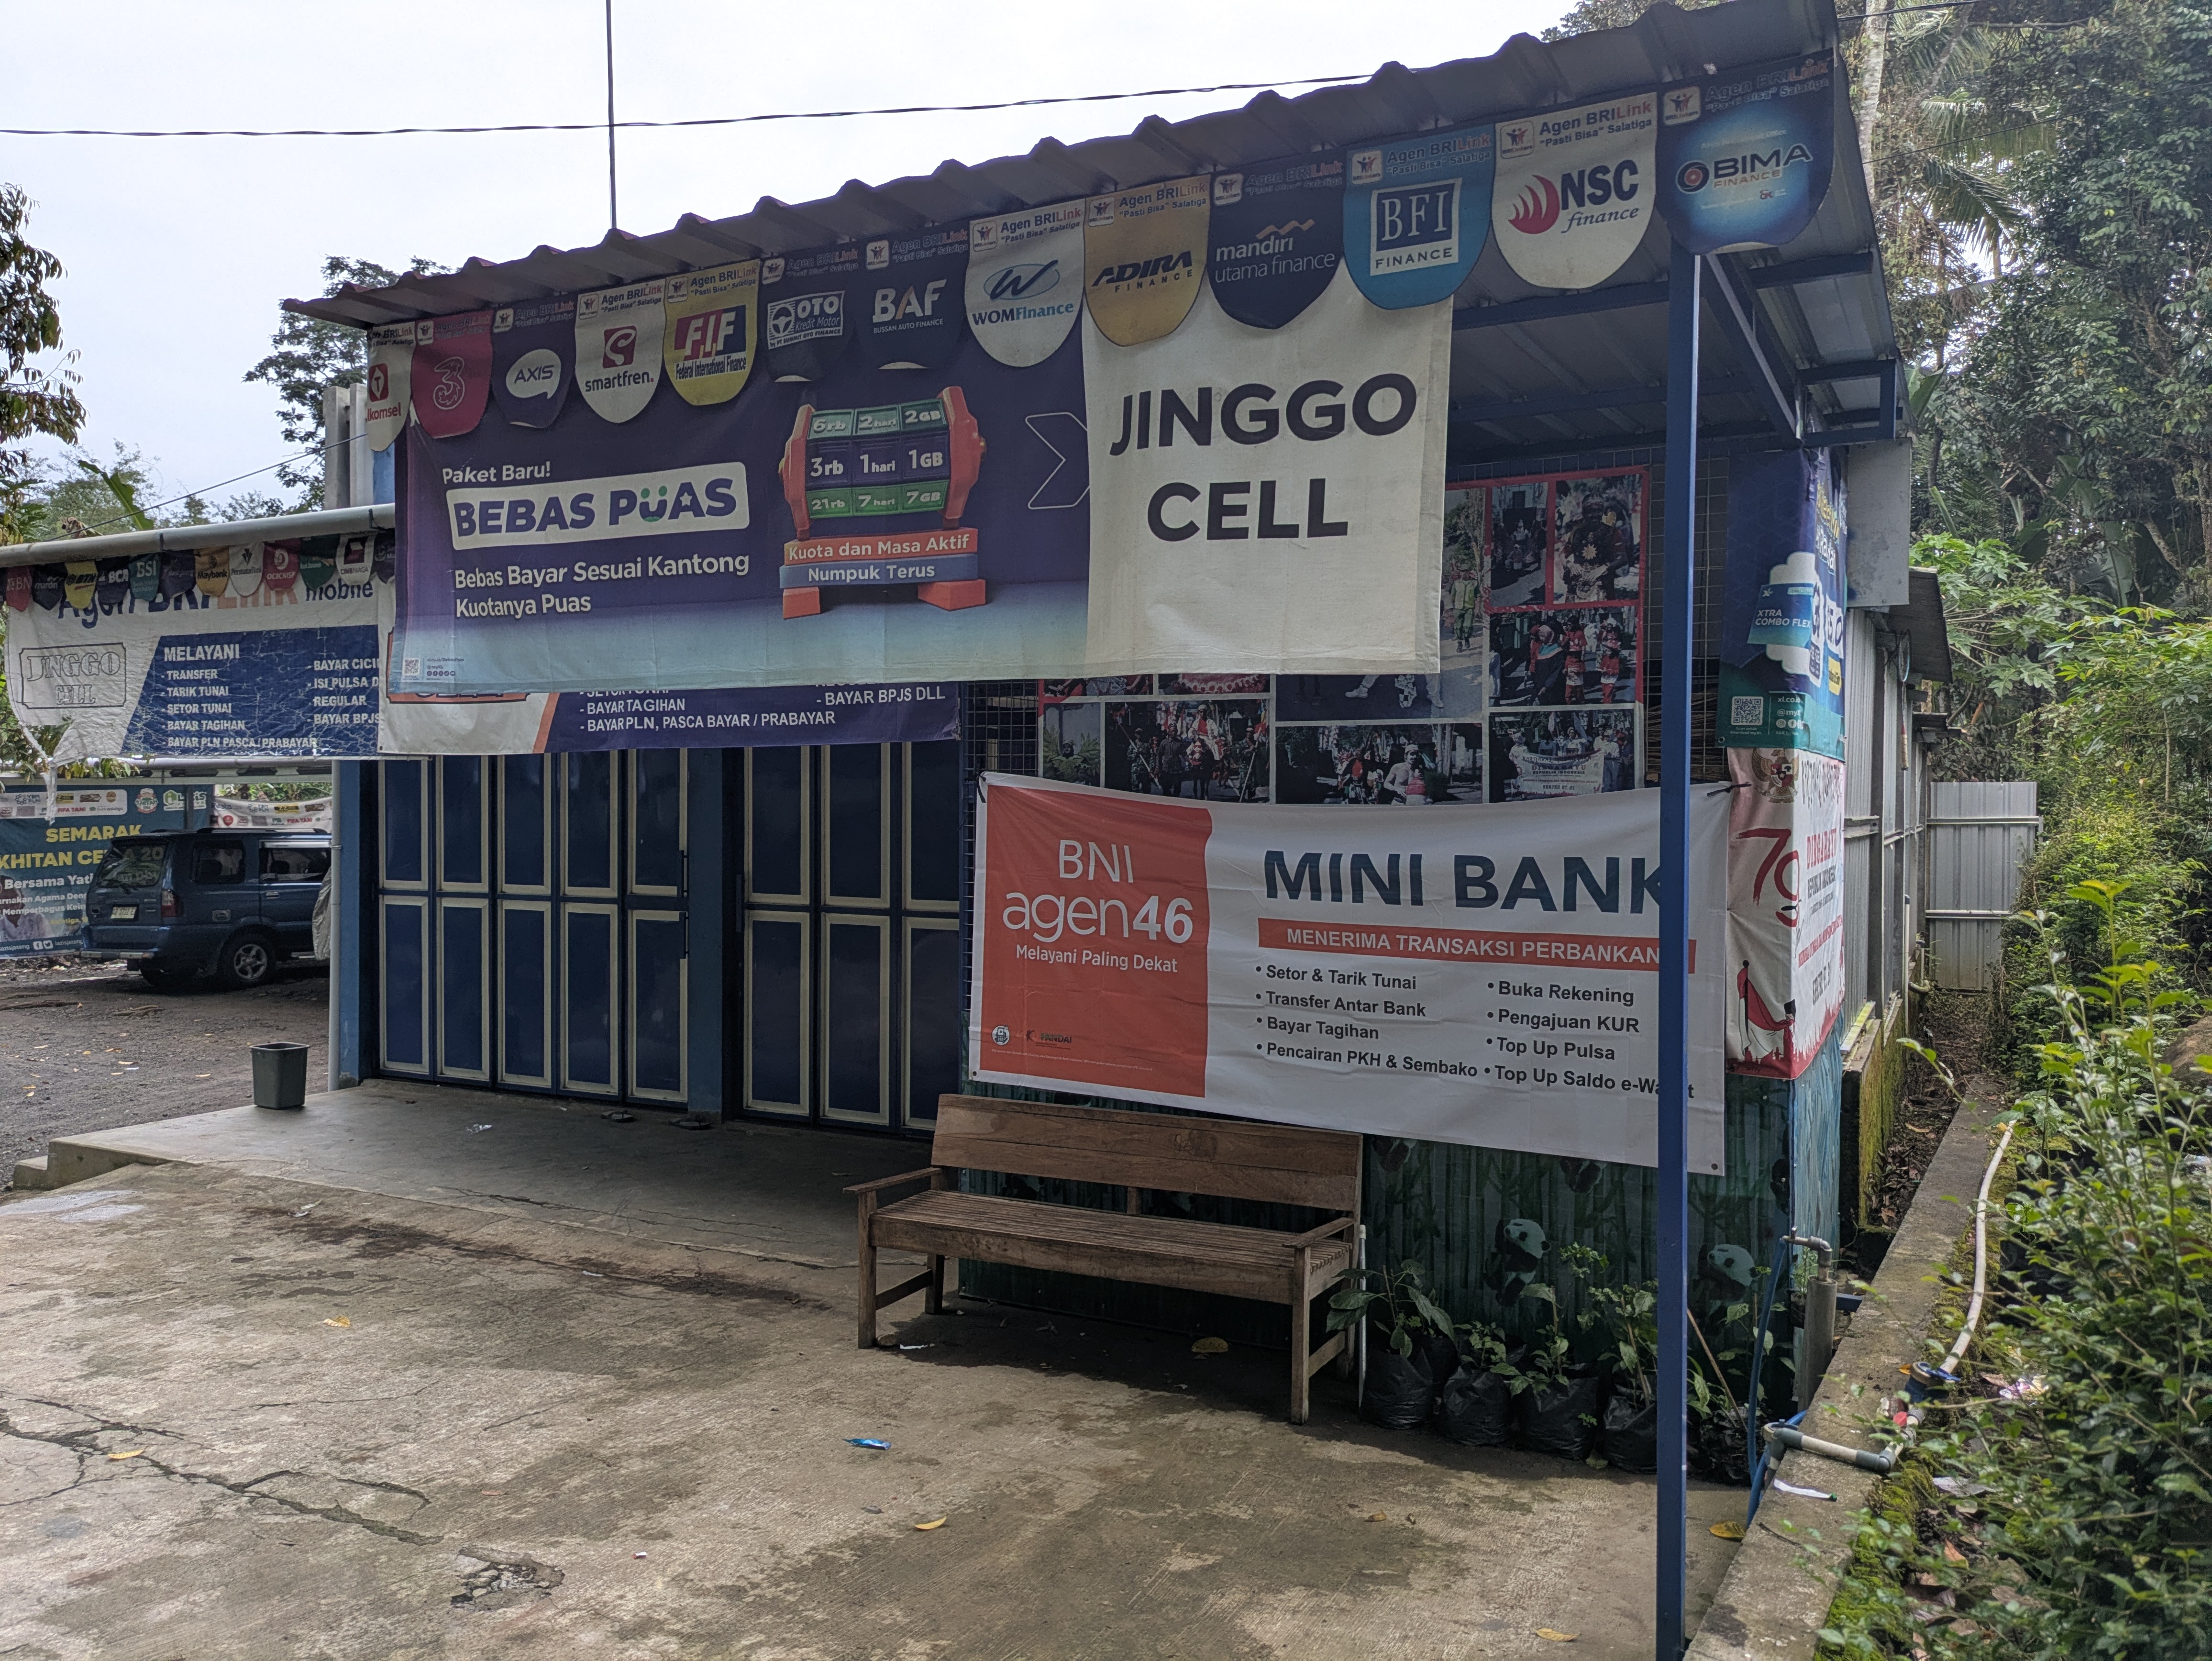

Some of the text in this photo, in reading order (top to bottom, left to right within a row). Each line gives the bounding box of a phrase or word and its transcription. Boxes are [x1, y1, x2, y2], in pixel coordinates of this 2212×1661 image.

[1539, 101, 1651, 135] Agen BRILink
[1607, 120, 1652, 133] Salatiga
[1387, 134, 1491, 164] Agen BRILink
[1450, 151, 1491, 164] Salatiga
[1714, 144, 1813, 178] BIMA
[1560, 159, 1639, 210] NSC
[1714, 170, 1781, 188] FINANCE
[1119, 182, 1206, 209] Agen BRILink
[1172, 198, 1206, 209] Salatiga
[1000, 208, 1081, 233] Agen BRILink
[1381, 191, 1449, 241] BFI
[1562, 207, 1639, 233] finance
[1050, 221, 1080, 233] Salatiga
[1216, 236, 1293, 261] mandiri
[1376, 248, 1452, 269] FINANCE
[690, 266, 757, 287] Agen BRILink
[1092, 251, 1193, 287] ADIRA
[1215, 253, 1335, 283] utama finance
[1115, 269, 1193, 293] FINANCE
[601, 284, 662, 305] Agen BRILink
[872, 279, 947, 323] BAF
[797, 296, 839, 319] OTO
[685, 311, 736, 356] FIF
[795, 316, 840, 332] Kredit Motor
[815, 329, 841, 337] FINANCE
[874, 318, 943, 333] BUSSAN AUTO FINANCE
[514, 365, 554, 384] AXIS
[675, 355, 747, 380] Federal International Finance
[366, 402, 401, 421] lkomsel
[1109, 373, 1416, 456] JINGGO
[442, 461, 551, 485] Paket Baru!
[453, 492, 596, 537] BEBAS
[1148, 478, 1349, 542] CELL
[789, 534, 969, 560] Kuota dan Masa Aktif
[109, 569, 129, 583] BCA
[136, 560, 156, 577] BSI
[197, 569, 227, 580] Maybank
[455, 554, 749, 588] Bebas Bayar Sesuai Kantong
[808, 565, 935, 583] Numpuk Terus
[456, 594, 591, 619] Kuotanya Puas
[1792, 619, 1811, 628] FLEX
[164, 643, 240, 662] MELAYANI
[167, 670, 218, 680] TRANSFER
[314, 659, 349, 671] BAYAR
[167, 686, 229, 697] TARIK TUNAI
[314, 677, 368, 689] ISI PULSA
[55, 684, 96, 705] CELL
[314, 695, 366, 707] REGULAR
[825, 686, 946, 705] BAYAR BPJS DLL
[167, 703, 232, 714] SETOR TUNAI
[587, 698, 685, 714] BAYAR TAGIHAN
[167, 720, 245, 731] BAYAR TAGIHAN
[314, 714, 352, 725] BAYAR
[587, 711, 836, 732] BAYAR PASCA BAYAR PRABAYAR
[168, 737, 199, 747] BAYAR
[201, 737, 220, 747] PLN
[46, 825, 142, 842] SEMARAK
[1059, 840, 1134, 883] BNI
[4, 877, 65, 889] Bersama
[1266, 850, 1661, 914] MINI BANK
[35, 894, 65, 903] Agama
[3, 904, 65, 916] Memperbagus
[1003, 892, 1193, 944] agen46
[1287, 928, 1660, 964] MENERIMA TRANSAKSI PERBANKAN
[1017, 945, 1177, 973] Melayani Paling Dekat
[1266, 964, 1417, 990] Setor & Tarik Tunai
[1266, 991, 1426, 1017] Transfer Antar Bank
[1499, 981, 1634, 1007] Buka Rekening
[1267, 1017, 1379, 1039] Bayar Tagihan
[1498, 1008, 1640, 1033] Pengajuan KUR
[1267, 1042, 1477, 1076] Pencairan PKH & Sembako
[1496, 1037, 1615, 1060] Top Up Pulsa
[1494, 1065, 1615, 1090] Top Up Saldo
